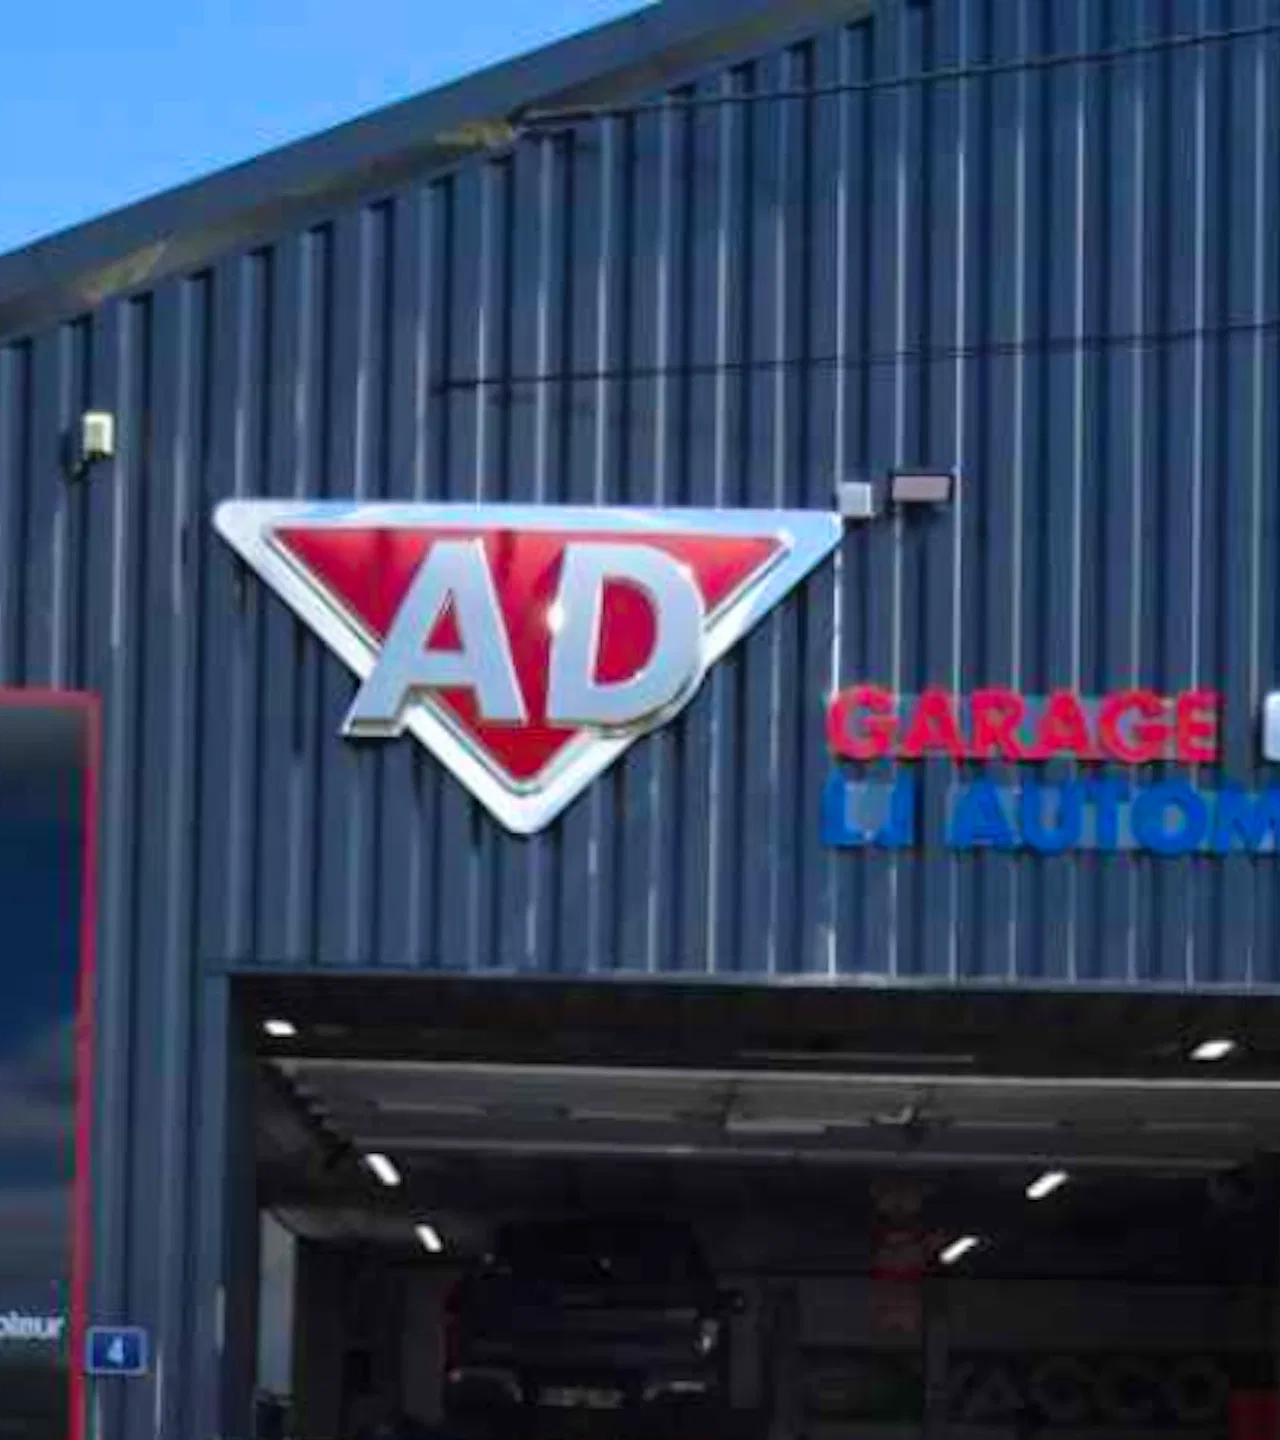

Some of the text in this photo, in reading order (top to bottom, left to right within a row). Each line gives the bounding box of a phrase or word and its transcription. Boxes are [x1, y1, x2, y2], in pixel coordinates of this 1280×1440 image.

[341, 537, 706, 738] AD
[825, 686, 1224, 764] GARAGE
[822, 768, 916, 848] LJ
